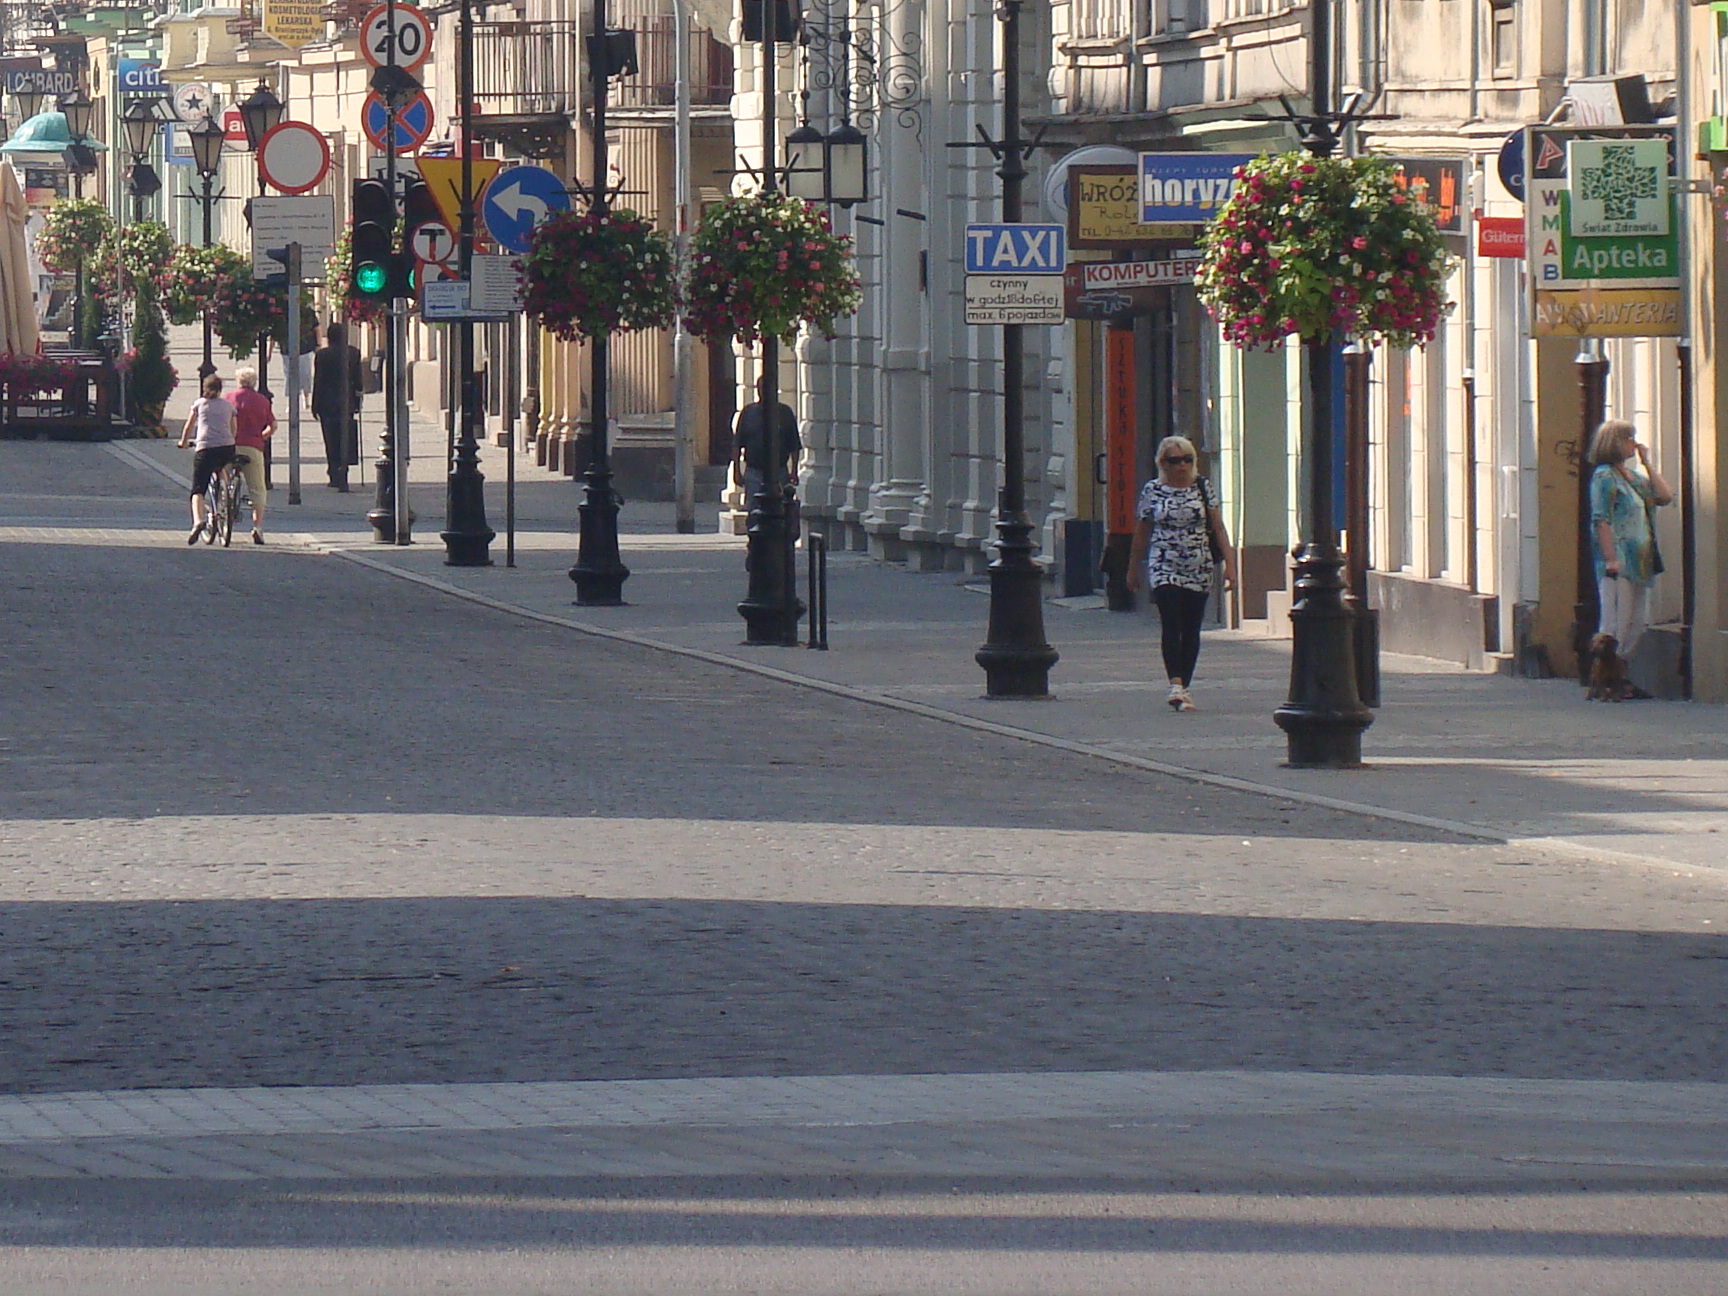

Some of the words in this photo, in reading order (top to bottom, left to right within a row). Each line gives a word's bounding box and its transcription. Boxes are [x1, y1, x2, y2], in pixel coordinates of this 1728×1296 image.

[269, 6, 322, 15] KOSMETOLOGIA
[277, 16, 312, 25] LEKARSKA
[374, 20, 421, 55] 20
[1582, 220, 1610, 233] Świat
[1614, 222, 1659, 233] Zdrowia
[967, 230, 1058, 267] TAXI
[1573, 243, 1668, 272] Apteka
[990, 280, 1029, 291] czynny
